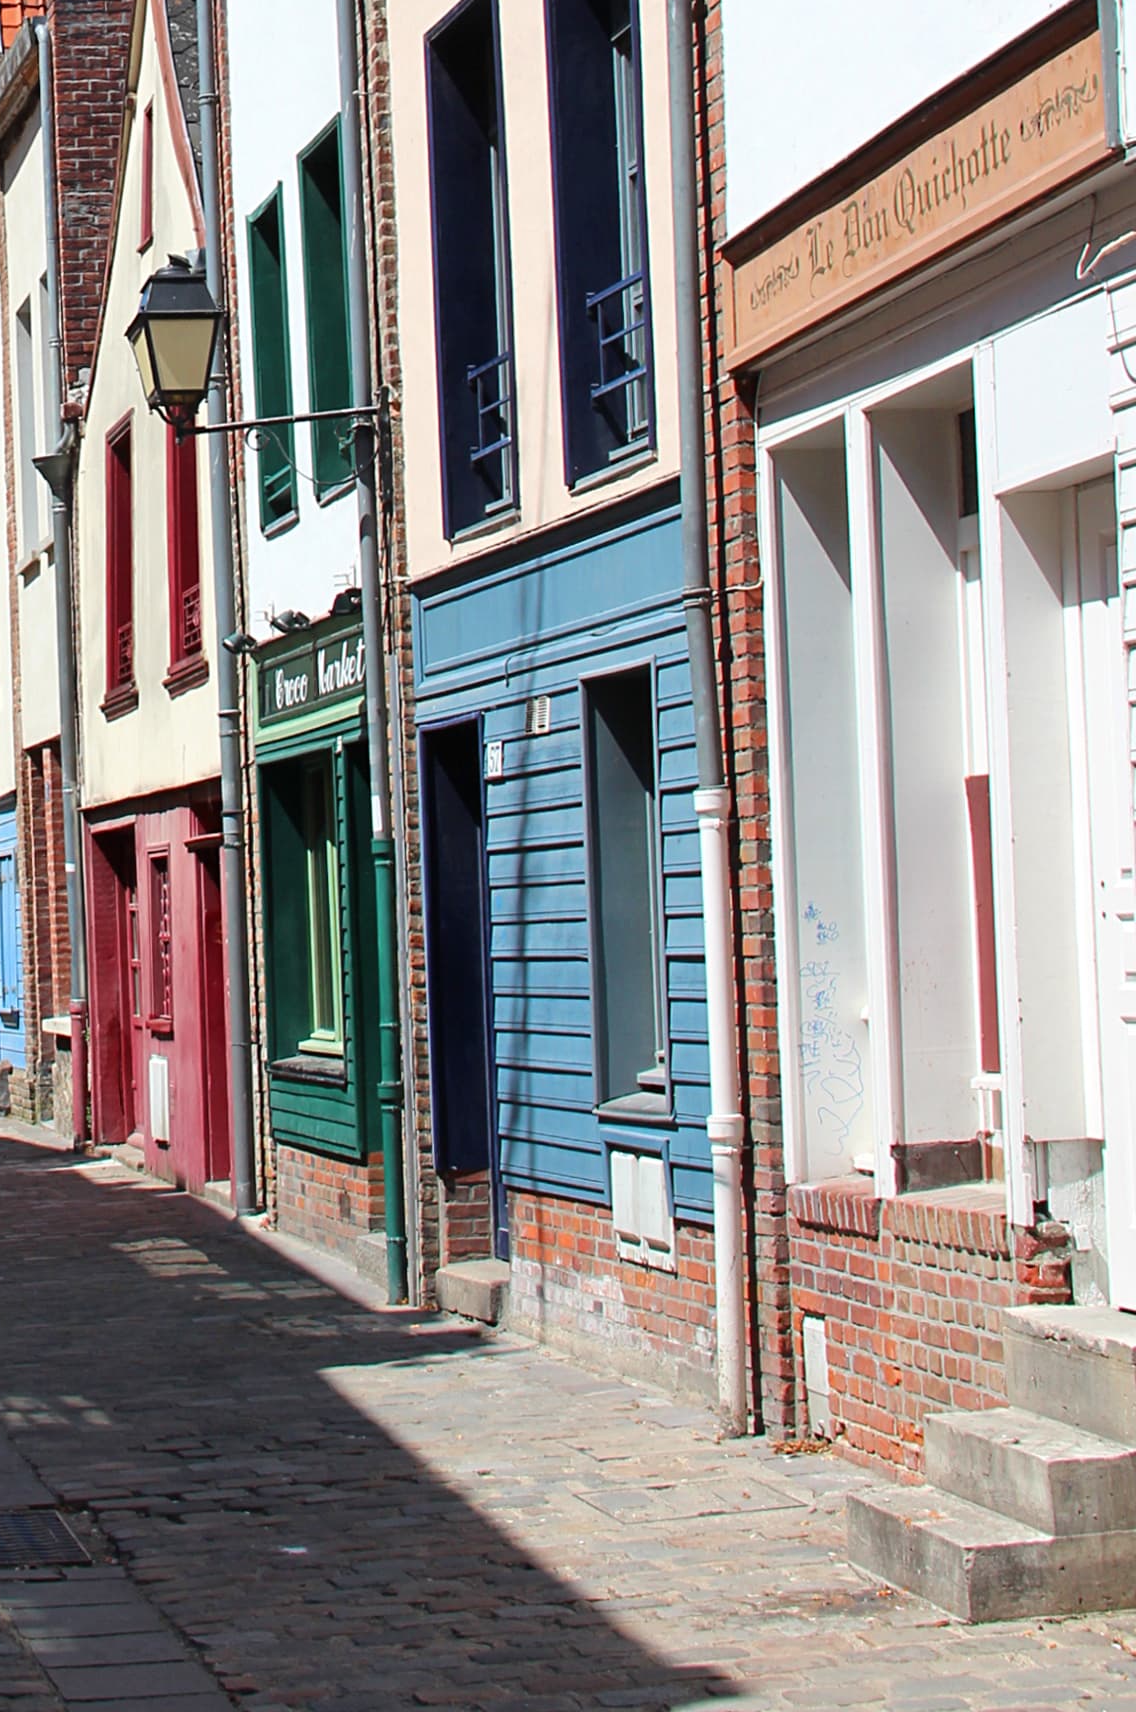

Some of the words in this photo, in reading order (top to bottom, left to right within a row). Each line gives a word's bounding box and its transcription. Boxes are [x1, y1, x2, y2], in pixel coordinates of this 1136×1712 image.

[806, 221, 834, 298] Le
[840, 198, 891, 279] Don
[892, 120, 1011, 238] Quichotte
